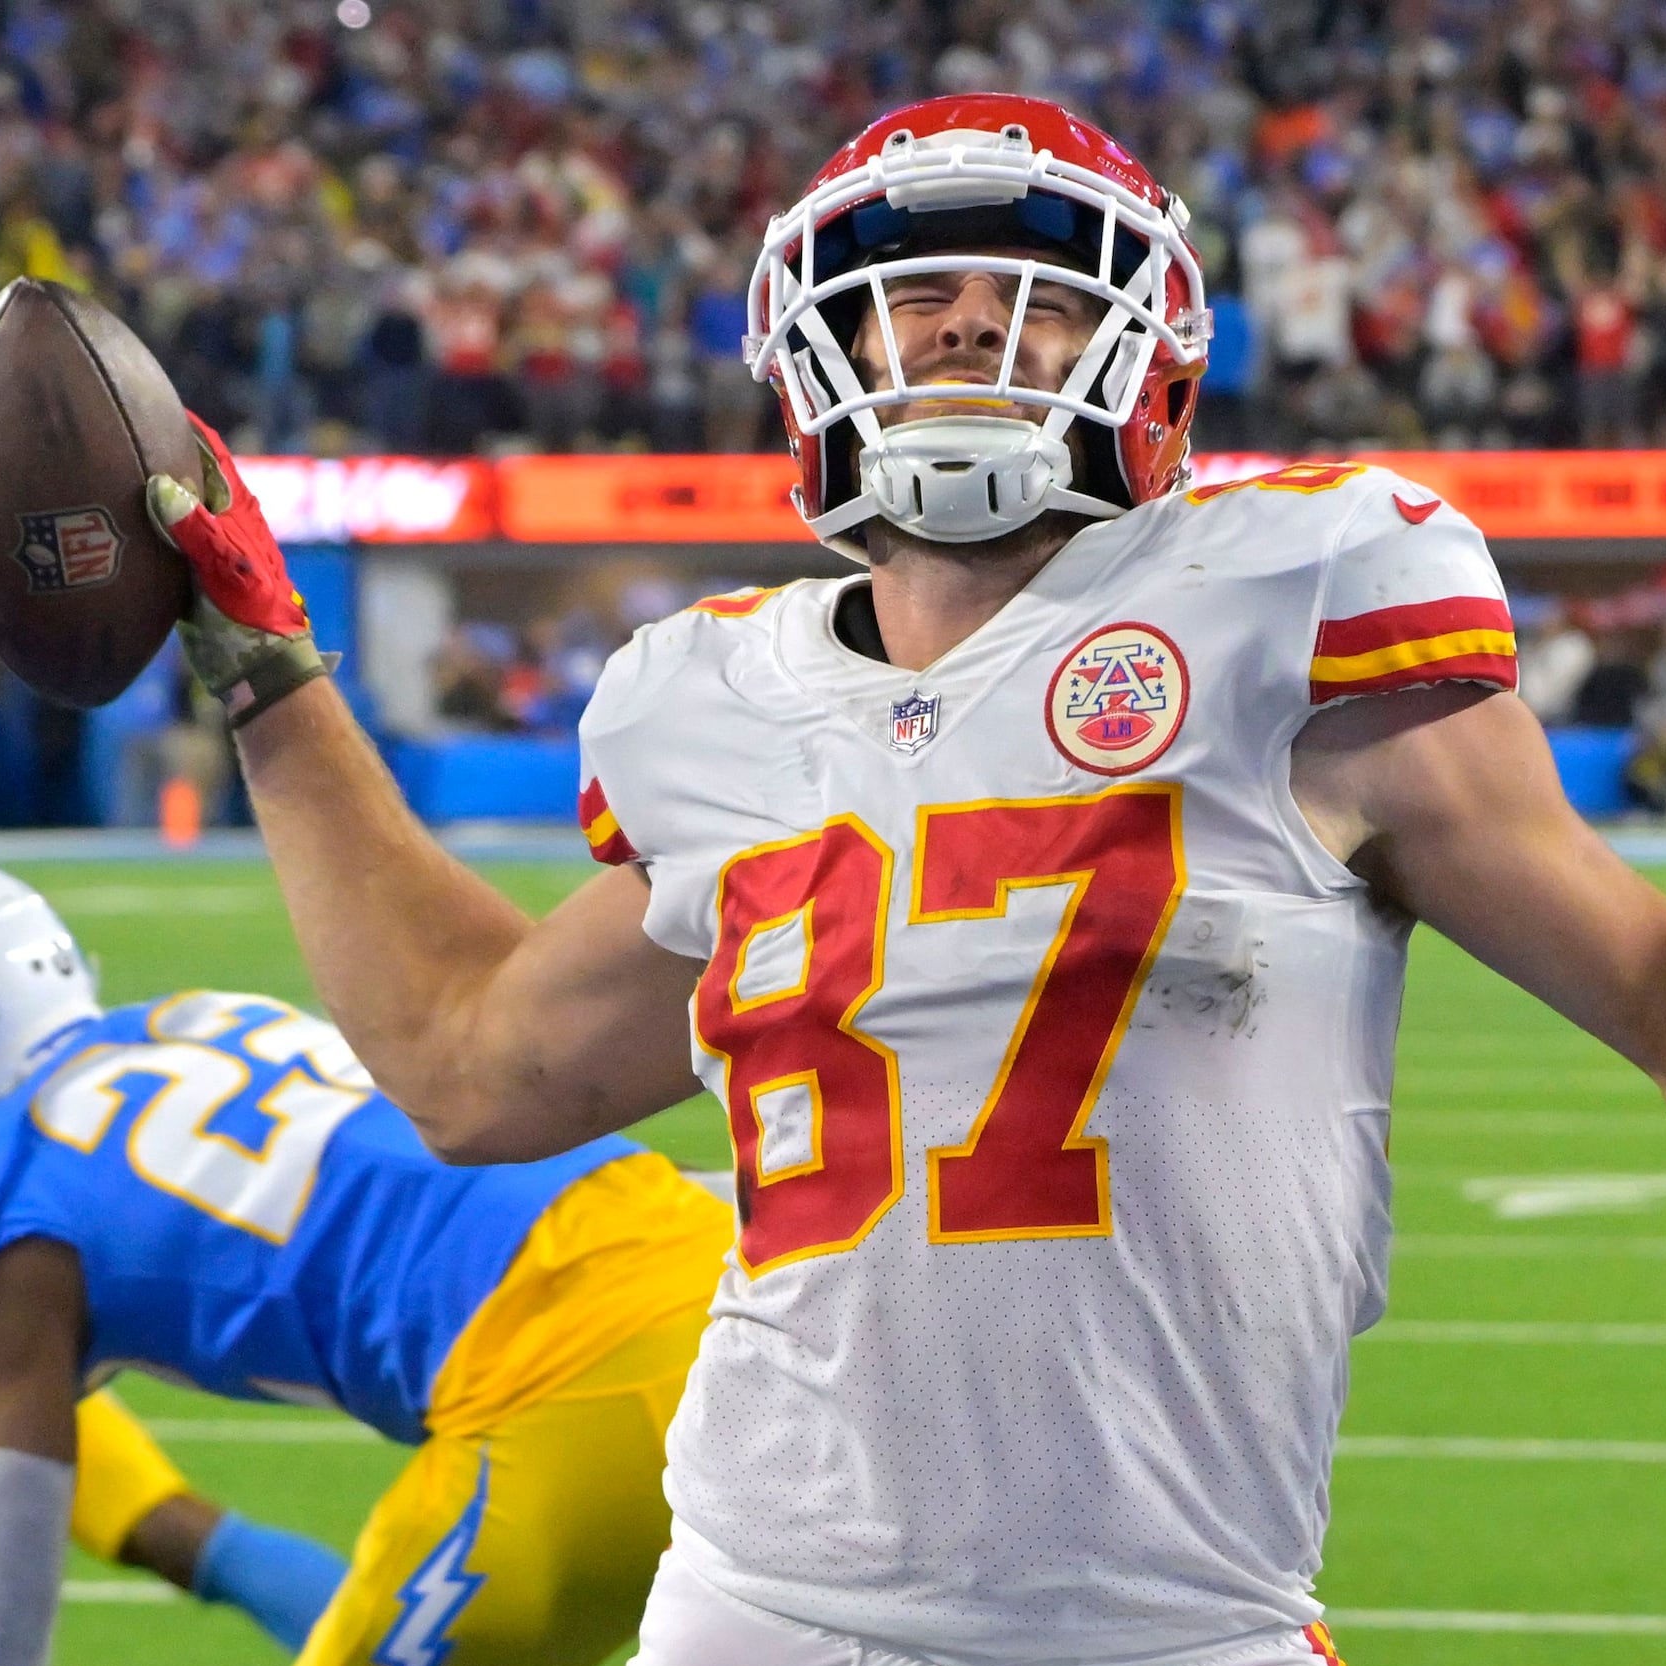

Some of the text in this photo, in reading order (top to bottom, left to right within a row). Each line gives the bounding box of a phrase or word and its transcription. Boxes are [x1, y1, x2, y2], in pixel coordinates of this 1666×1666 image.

[60, 514, 113, 582] NFL
[1066, 643, 1166, 718] A
[895, 715, 929, 742] NFL
[696, 782, 1187, 1281] 87
[32, 989, 375, 1245] 22
